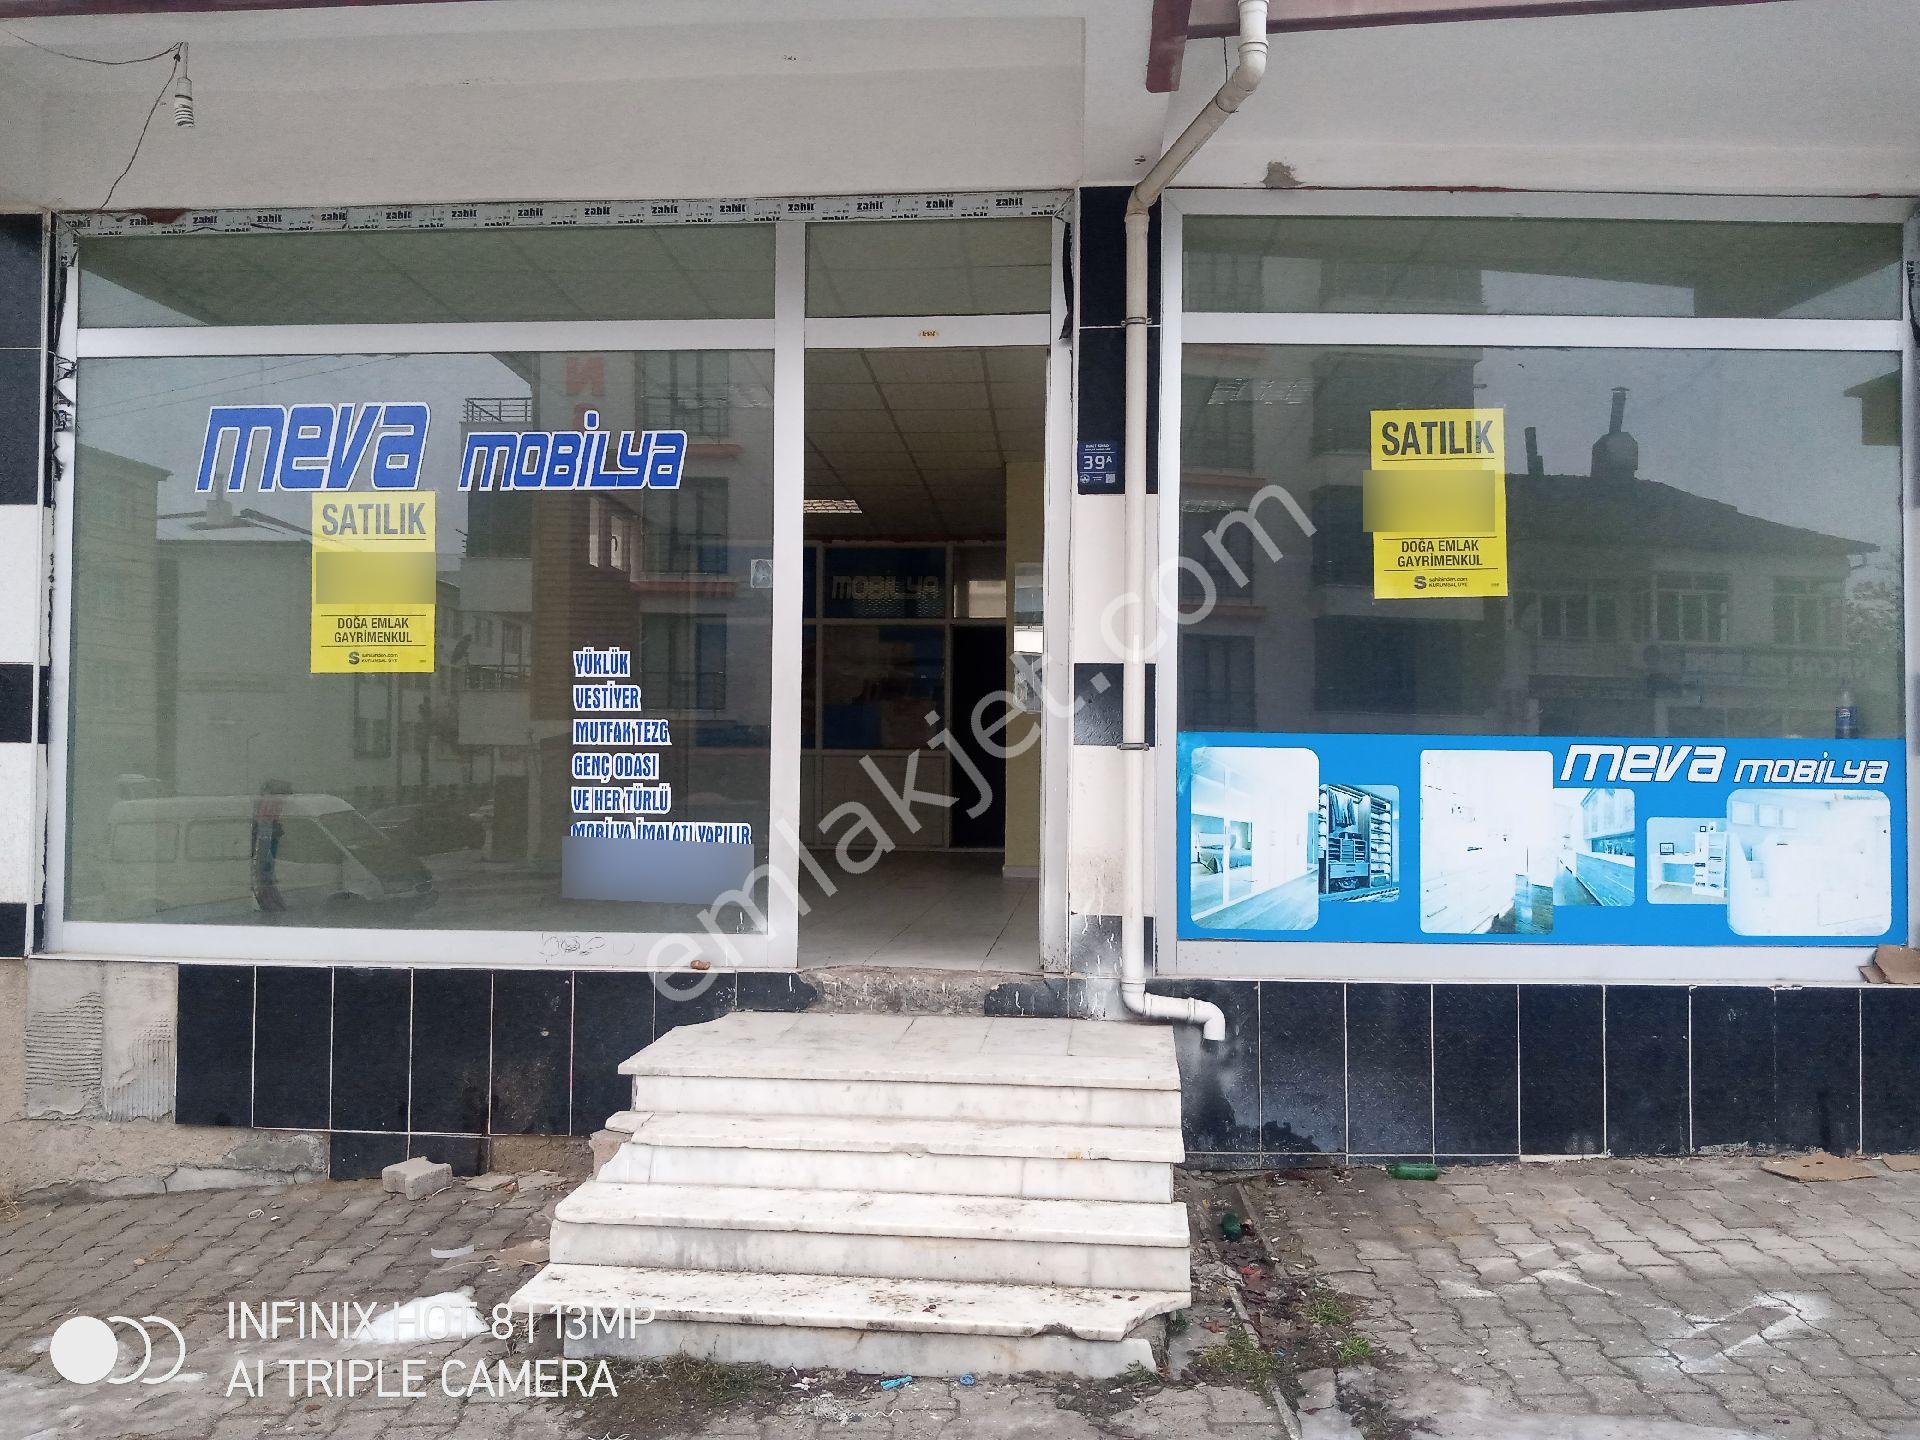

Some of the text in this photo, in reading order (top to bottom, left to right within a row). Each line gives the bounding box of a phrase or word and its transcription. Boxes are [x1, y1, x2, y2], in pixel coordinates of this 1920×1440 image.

[1381, 420, 1495, 456] SATILIK
[322, 503, 426, 536] SATILIK
[1401, 538, 1479, 553] DOĞA EMLAK
[1397, 553, 1483, 568] GAYRİMENKUL
[337, 616, 409, 629] DOĞA EMLAK
[334, 630, 412, 643] GAYRİMENKUL
[574, 648, 630, 676] YÜKLÜK
[574, 682, 640, 710] VESTİYER
[575, 721, 670, 744] MUTFAK TEZG
[574, 755, 657, 782] GENÇ ODASI
[573, 784, 669, 811] VE HER TÜRLÜ
